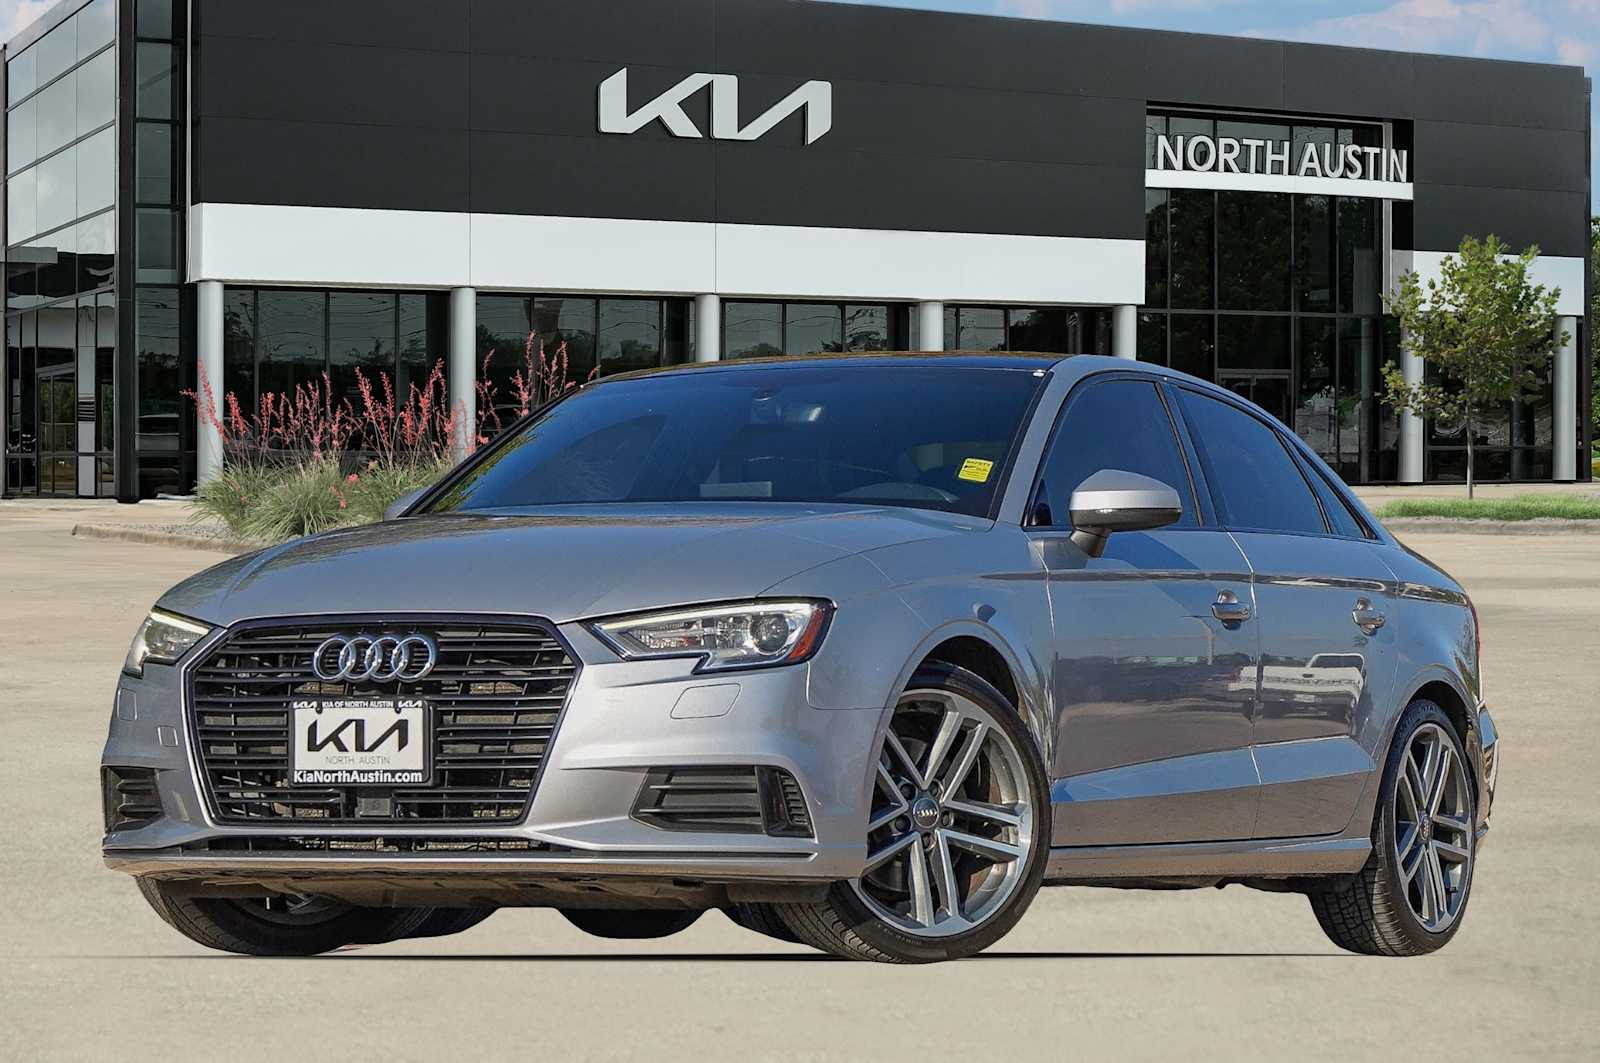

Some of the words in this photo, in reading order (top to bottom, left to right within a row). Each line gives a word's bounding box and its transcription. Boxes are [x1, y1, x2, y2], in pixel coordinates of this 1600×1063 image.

[598, 67, 832, 145] KIA
[1157, 135, 1290, 176] NORTH
[1299, 142, 1407, 183] AUSTIN
[308, 719, 408, 752] KIA
[294, 770, 422, 783] KiaNorthAustin.com
[326, 756, 355, 765] NORTH
[359, 756, 390, 765] AUSTIN
